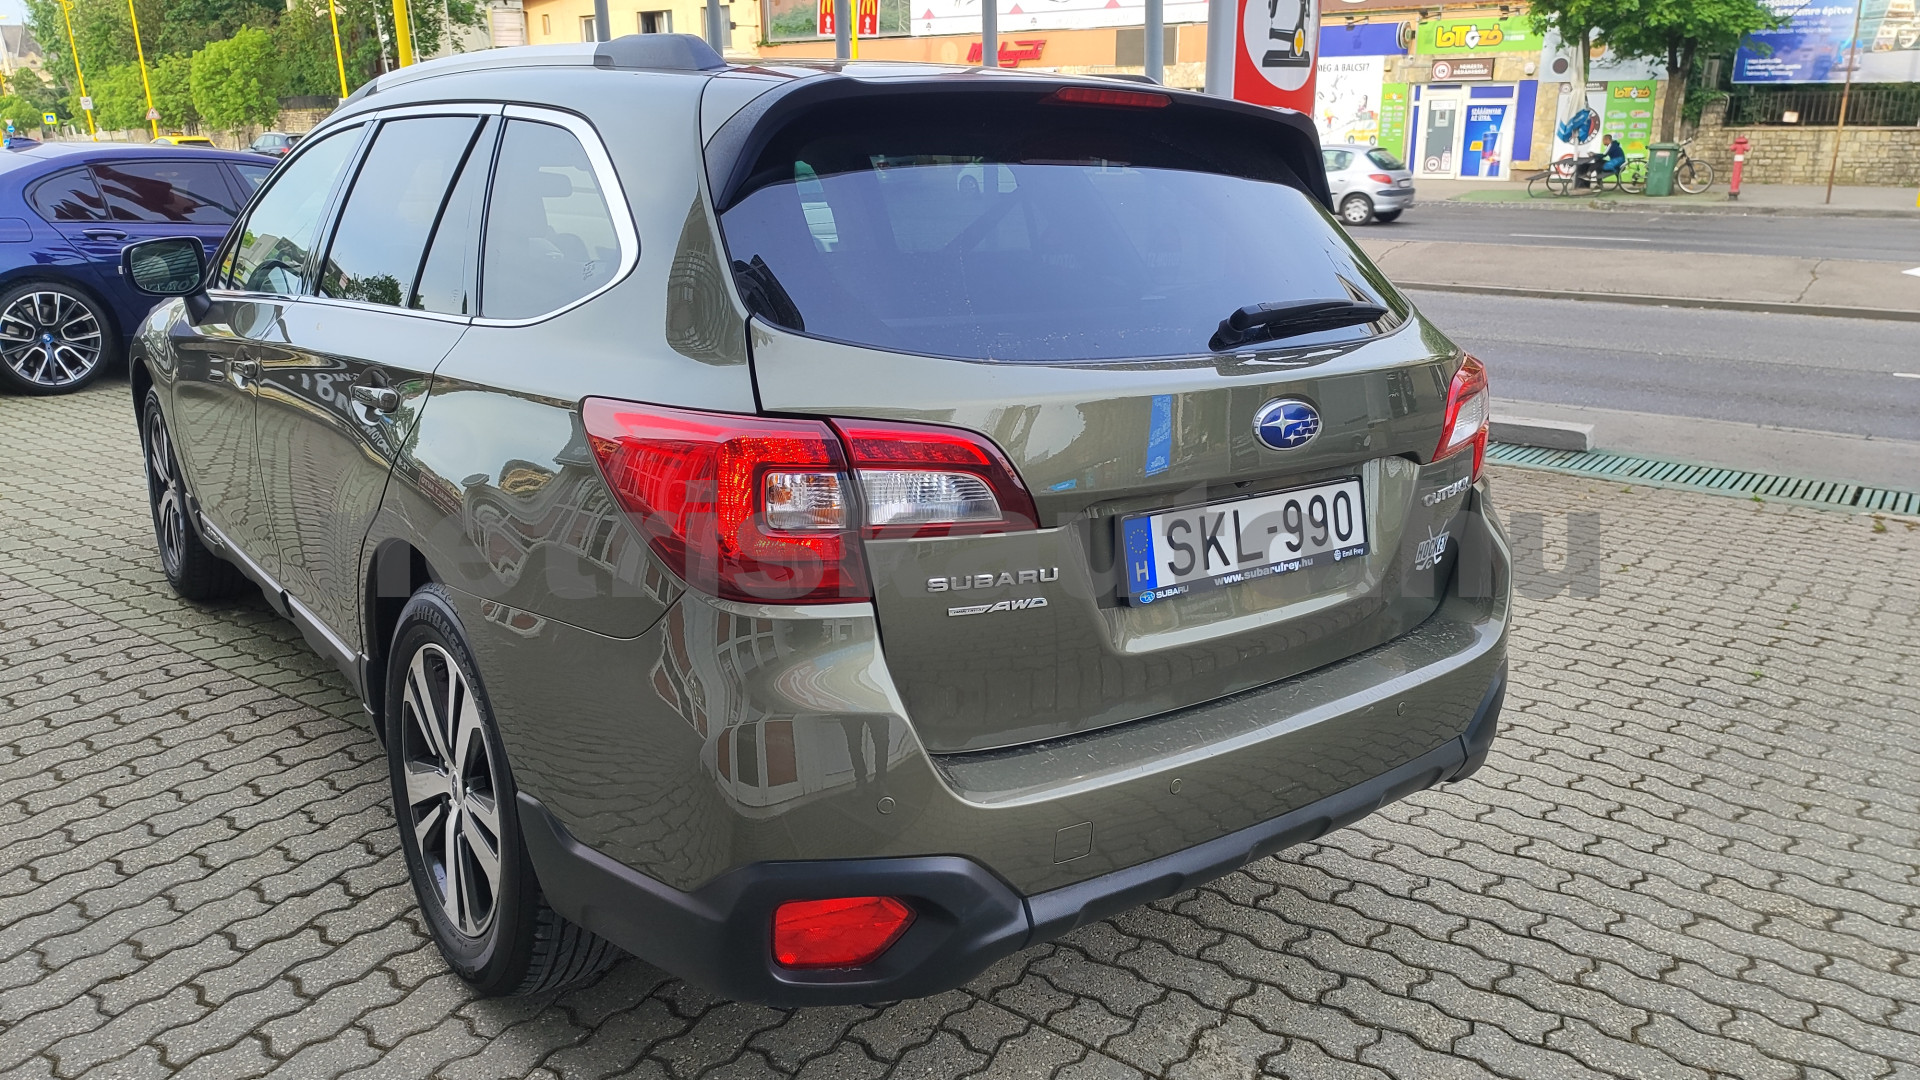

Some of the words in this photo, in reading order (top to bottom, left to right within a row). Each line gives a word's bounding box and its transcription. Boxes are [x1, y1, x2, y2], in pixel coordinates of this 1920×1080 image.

[927, 567, 1059, 593] SUBARU
[1136, 561, 1150, 582] H
[1214, 557, 1314, 586] www.subarufrey.hu
[1155, 585, 1190, 599] SUBARU
[985, 597, 1048, 613] AWD
